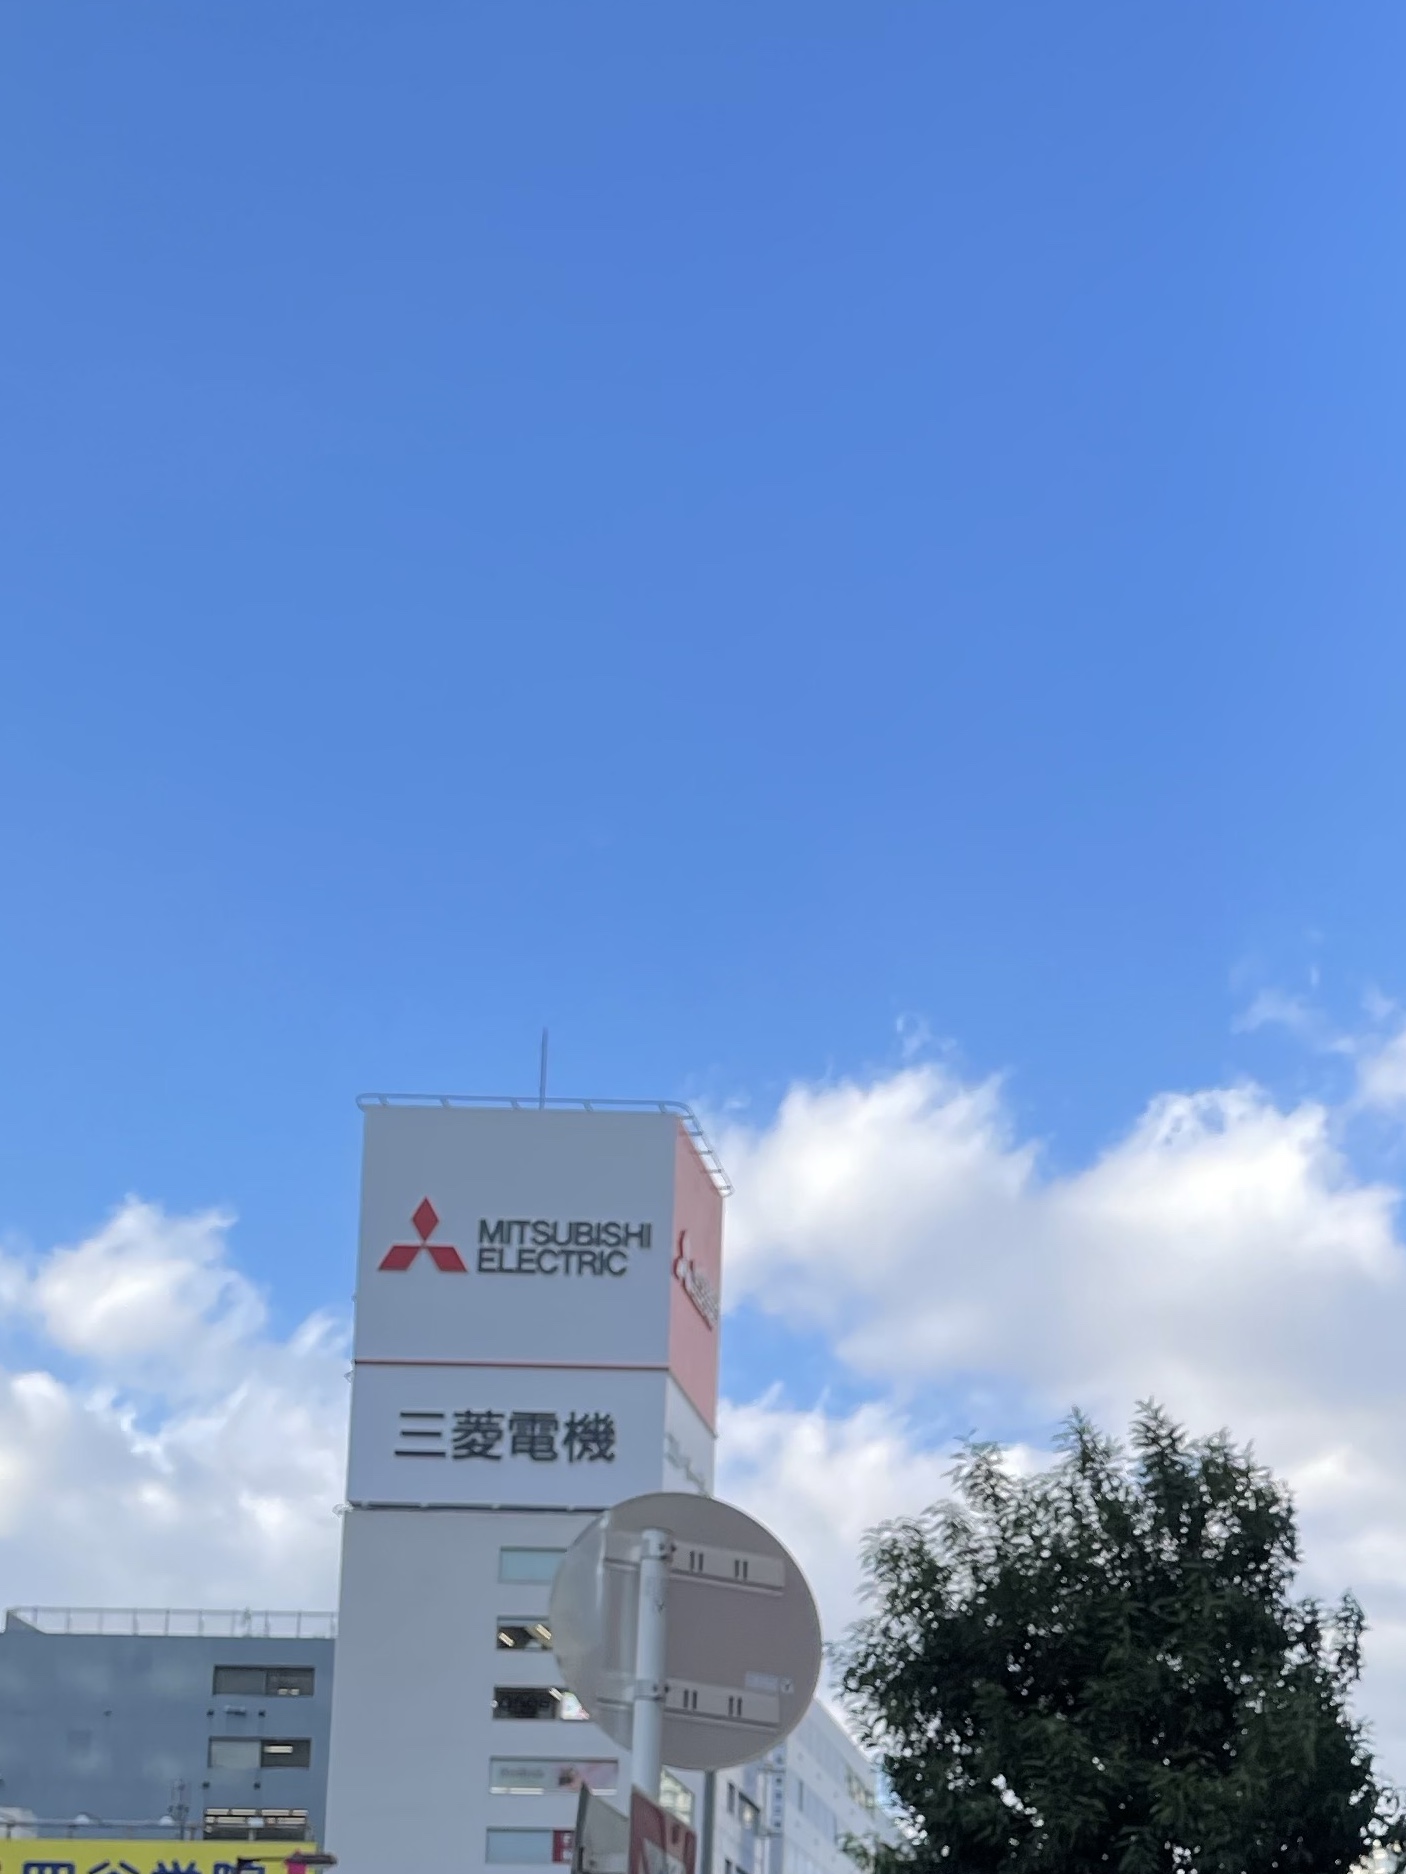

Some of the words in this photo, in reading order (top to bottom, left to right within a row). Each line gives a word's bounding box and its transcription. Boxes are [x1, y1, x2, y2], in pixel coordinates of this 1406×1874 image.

[477, 1218, 654, 1250] MITSUBISHI
[477, 1249, 629, 1278] ELECTRIC
[394, 1409, 617, 1464] 三菱電機
